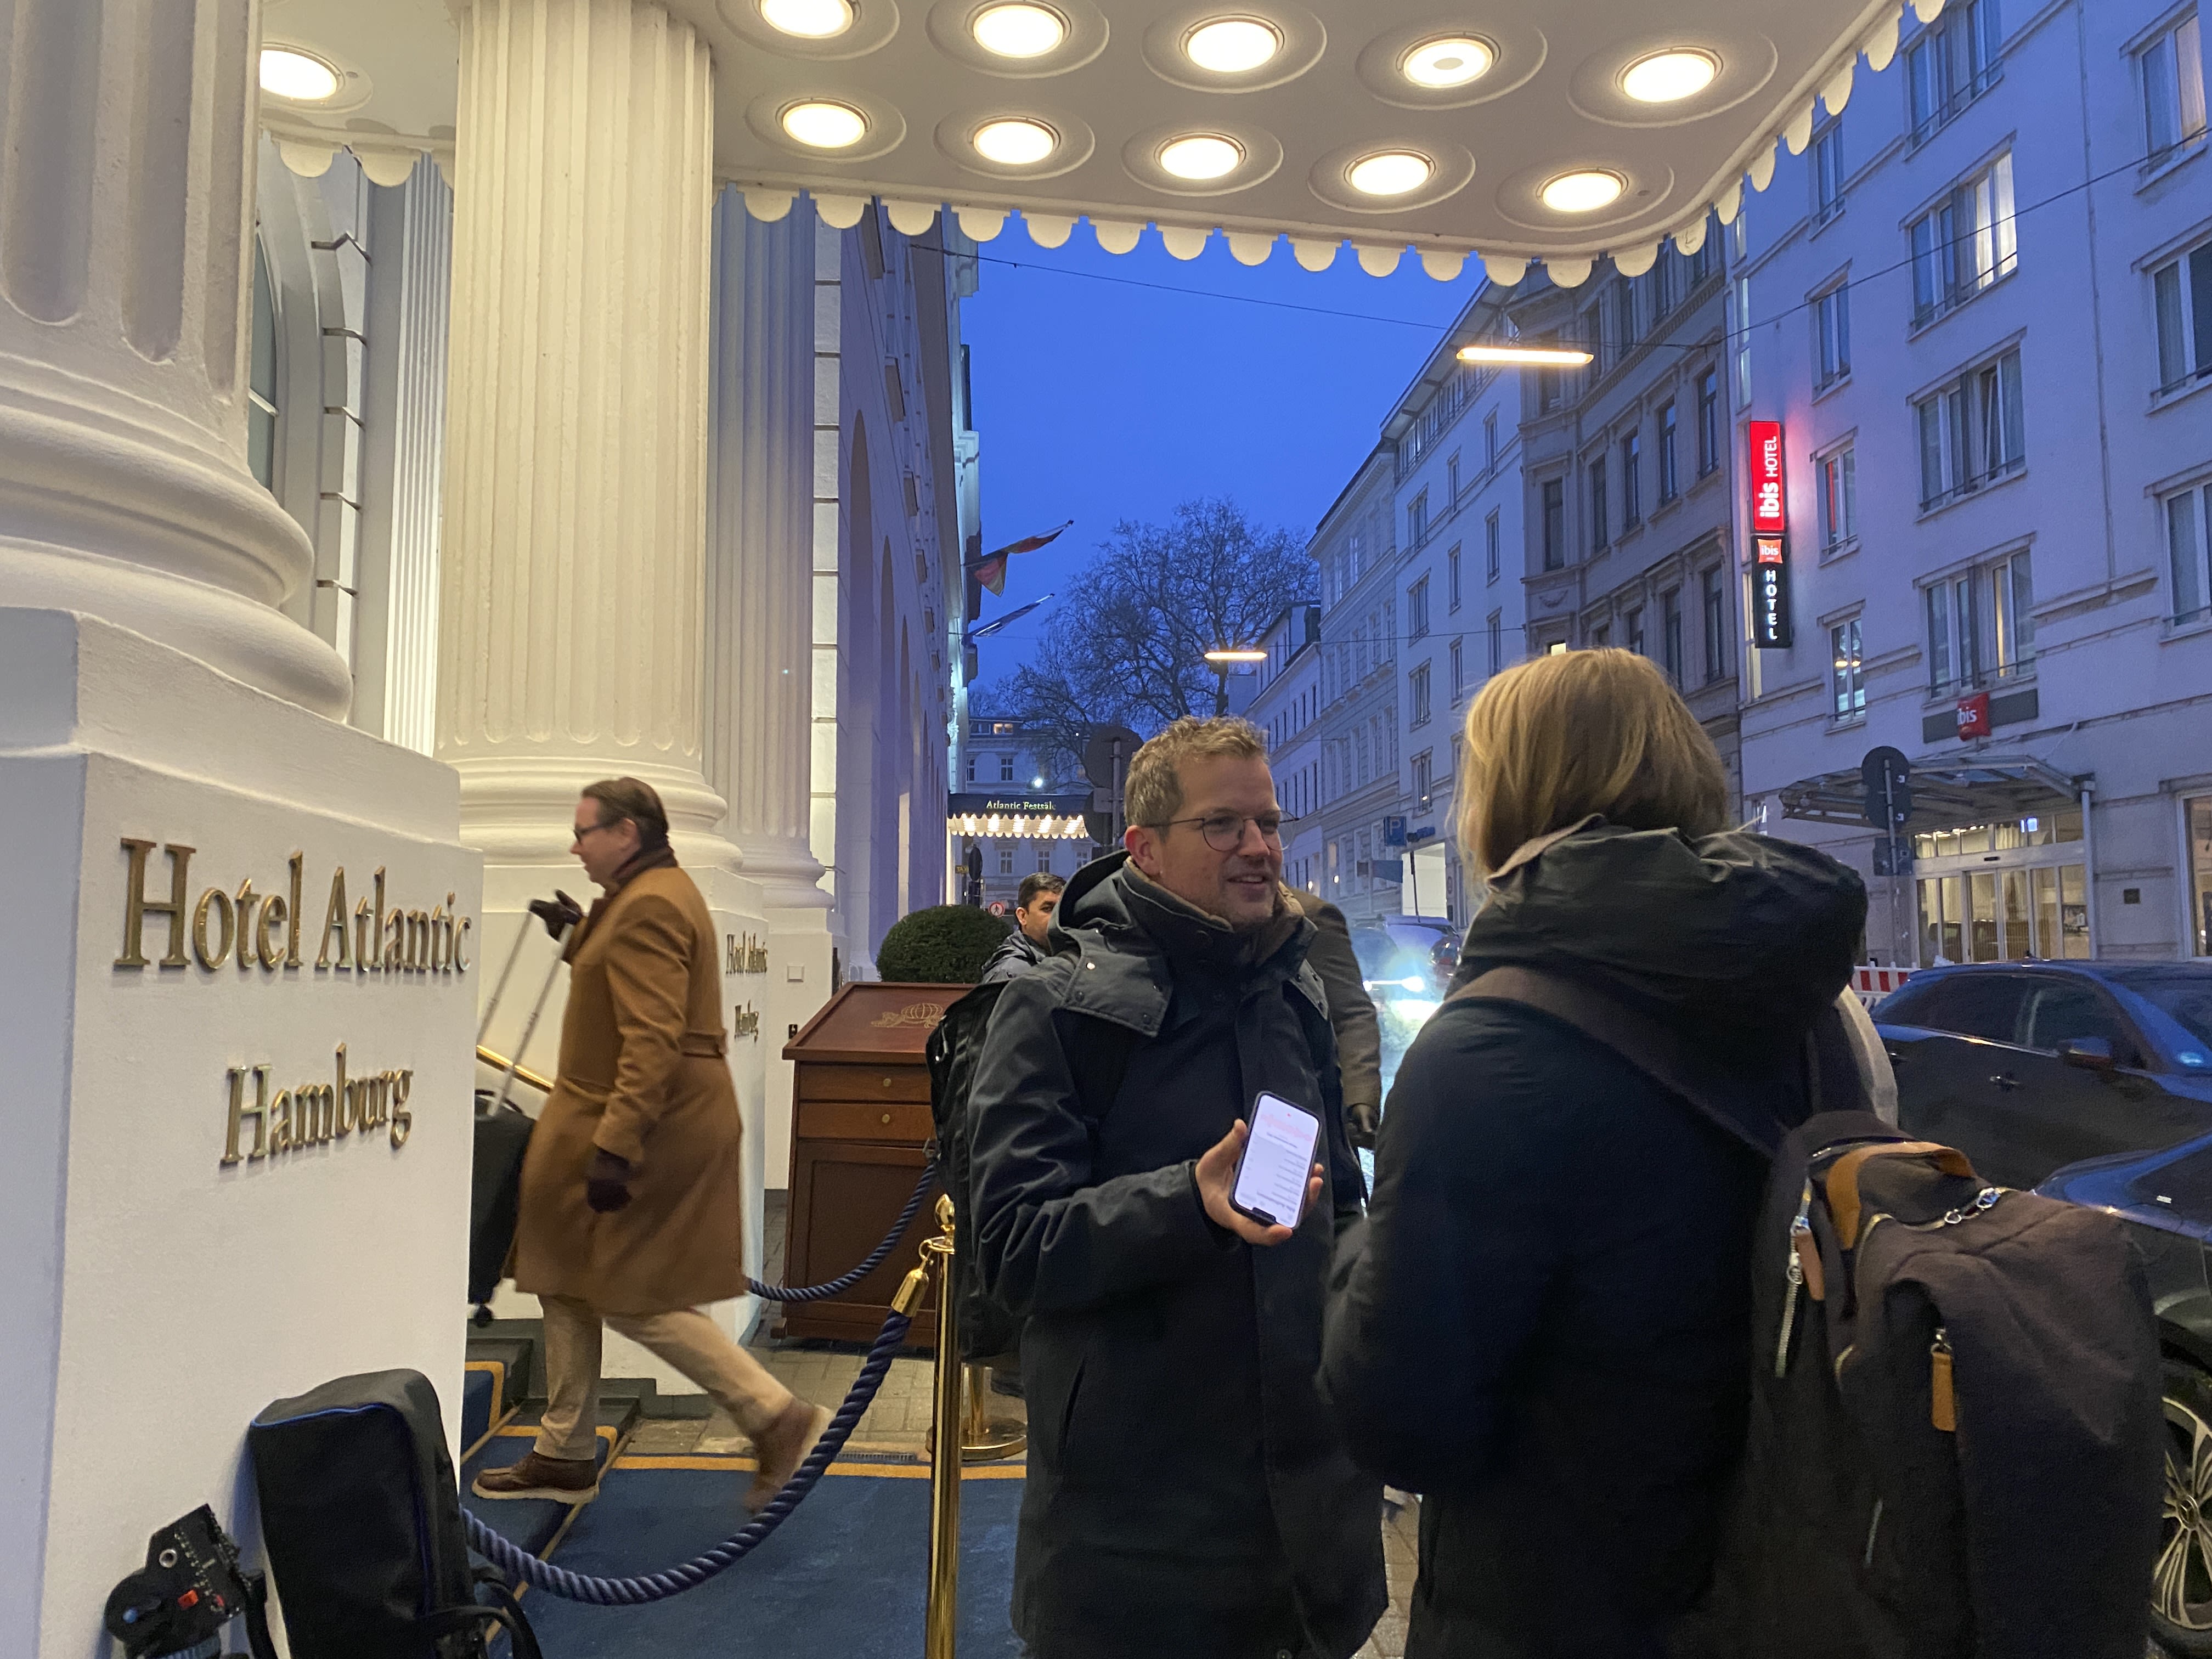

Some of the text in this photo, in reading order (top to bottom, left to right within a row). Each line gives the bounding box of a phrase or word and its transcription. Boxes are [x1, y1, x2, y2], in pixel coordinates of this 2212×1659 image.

[1759, 436, 1780, 518] ibis HOTEL
[1761, 545, 1779, 556] ibis
[1765, 569, 1778, 640] HOTEL
[986, 800, 1021, 809] Atlantic
[1389, 819, 1401, 836] P
[114, 838, 472, 973] Hotel Atlantic
[220, 1043, 413, 1165] Hamburg
